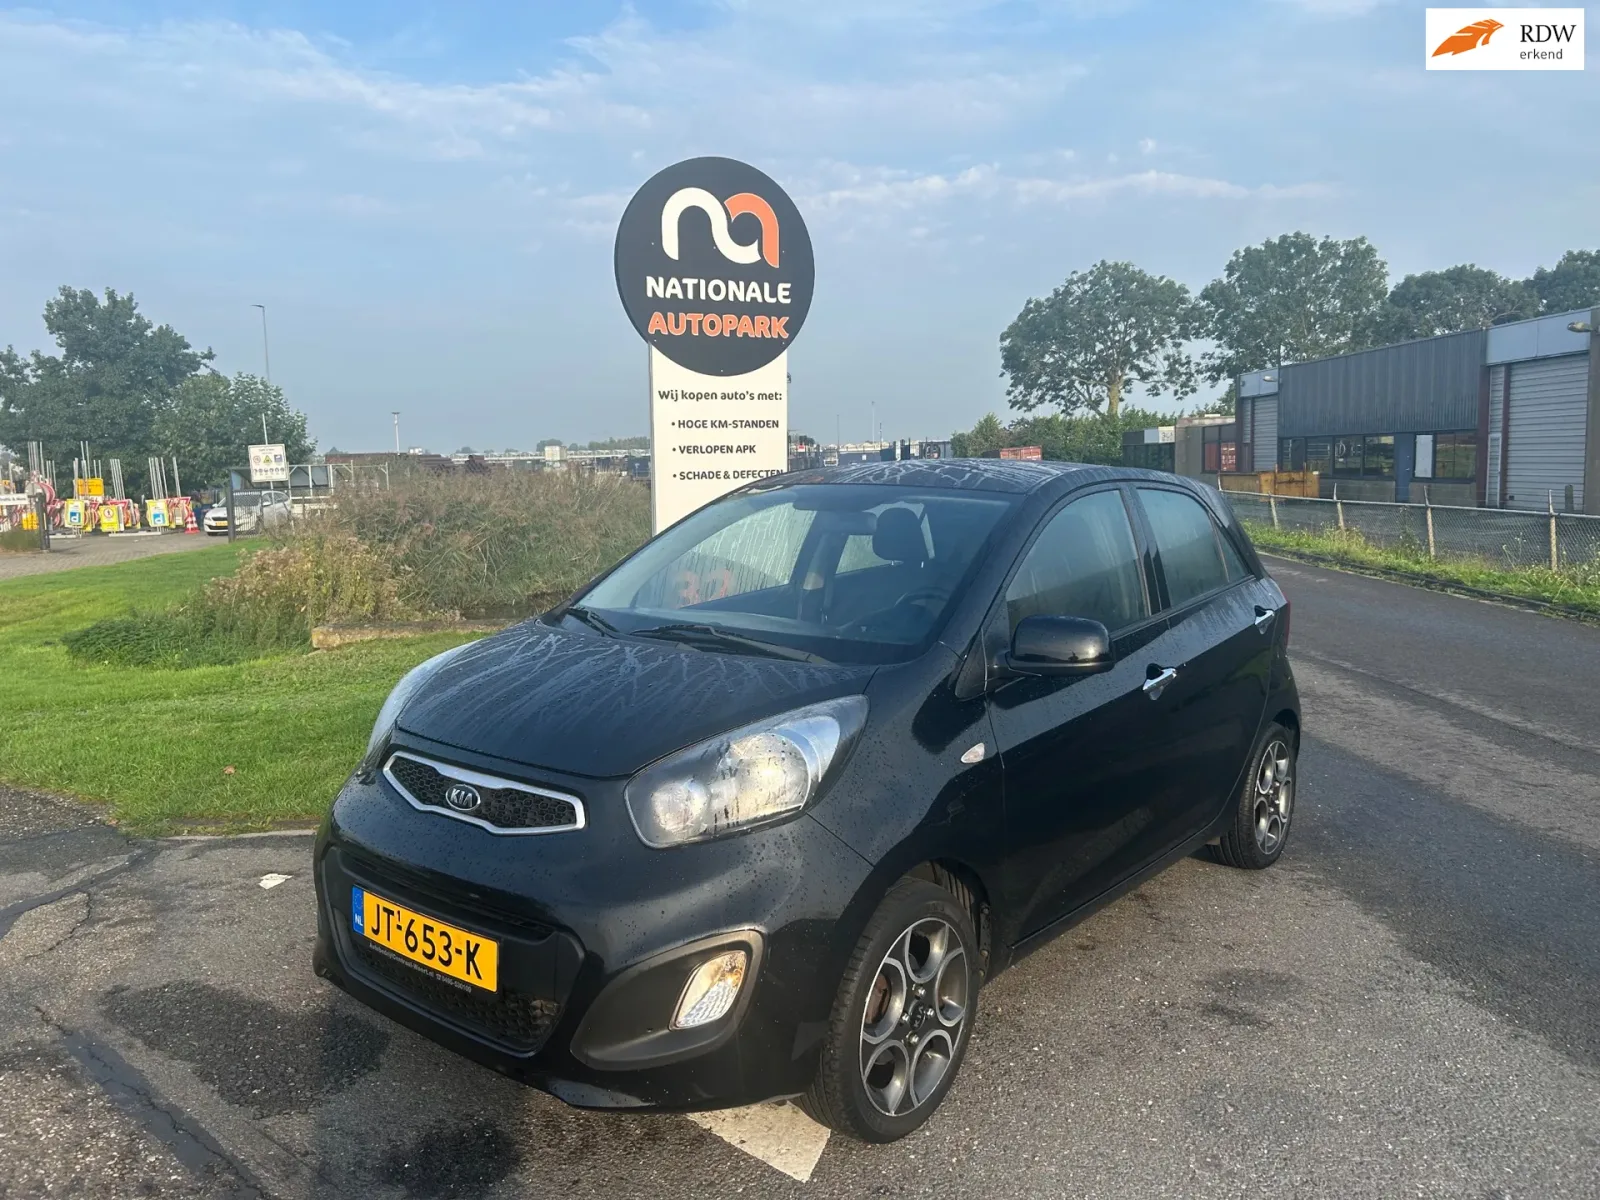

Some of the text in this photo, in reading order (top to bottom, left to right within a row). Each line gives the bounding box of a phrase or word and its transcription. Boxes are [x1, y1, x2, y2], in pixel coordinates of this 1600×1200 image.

[646, 275, 792, 304] NATIONALE
[648, 312, 790, 339] AUTOPARK
[658, 389, 783, 402] Wij kopen auto's met:
[678, 419, 780, 429] HOGE KM-STANDEN
[678, 444, 757, 454] VERLOPEN APK
[679, 470, 722, 480] SCHADE
[723, 470, 731, 480] &
[451, 788, 473, 807] KIA
[355, 913, 364, 927] NL
[371, 903, 483, 980] JT-653-K
[913, 1005, 924, 1028] KIA
